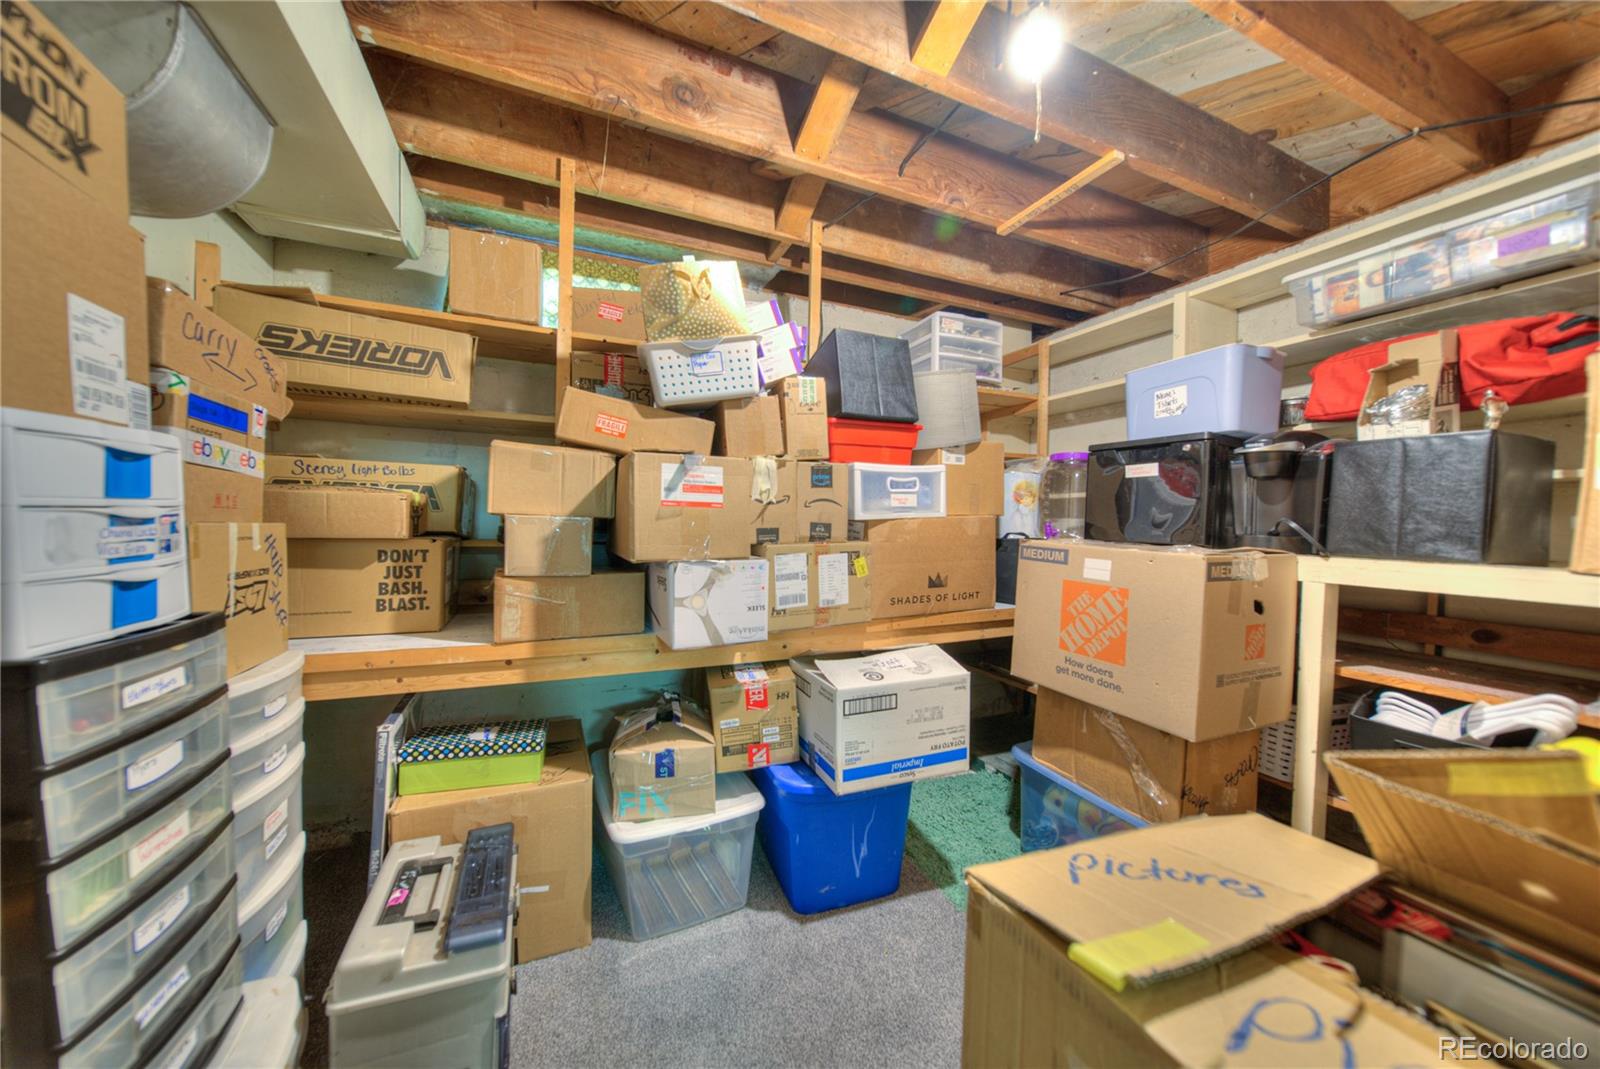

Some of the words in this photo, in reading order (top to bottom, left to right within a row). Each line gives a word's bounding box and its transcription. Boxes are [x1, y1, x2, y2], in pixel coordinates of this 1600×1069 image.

[256, 322, 454, 381] VORTEKS
[193, 437, 231, 465] ebay
[377, 549, 429, 563] DON'T
[1023, 548, 1065, 562] MEDIUM
[383, 565, 423, 579] JUST
[378, 581, 428, 596] BASH.
[375, 597, 430, 612] BLAST.
[889, 594, 932, 606] SHADES
[935, 593, 948, 602] OF
[952, 591, 980, 601] LIGHT
[1067, 590, 1095, 616] THE
[1060, 588, 1127, 653] HOME
[1084, 618, 1127, 658] DEPOT
[1064, 656, 1084, 669] How
[1086, 664, 1114, 679] doers
[1055, 665, 1070, 676] get
[1071, 670, 1095, 684] more
[1096, 678, 1125, 694] done.
[891, 758, 924, 772] Imperial
